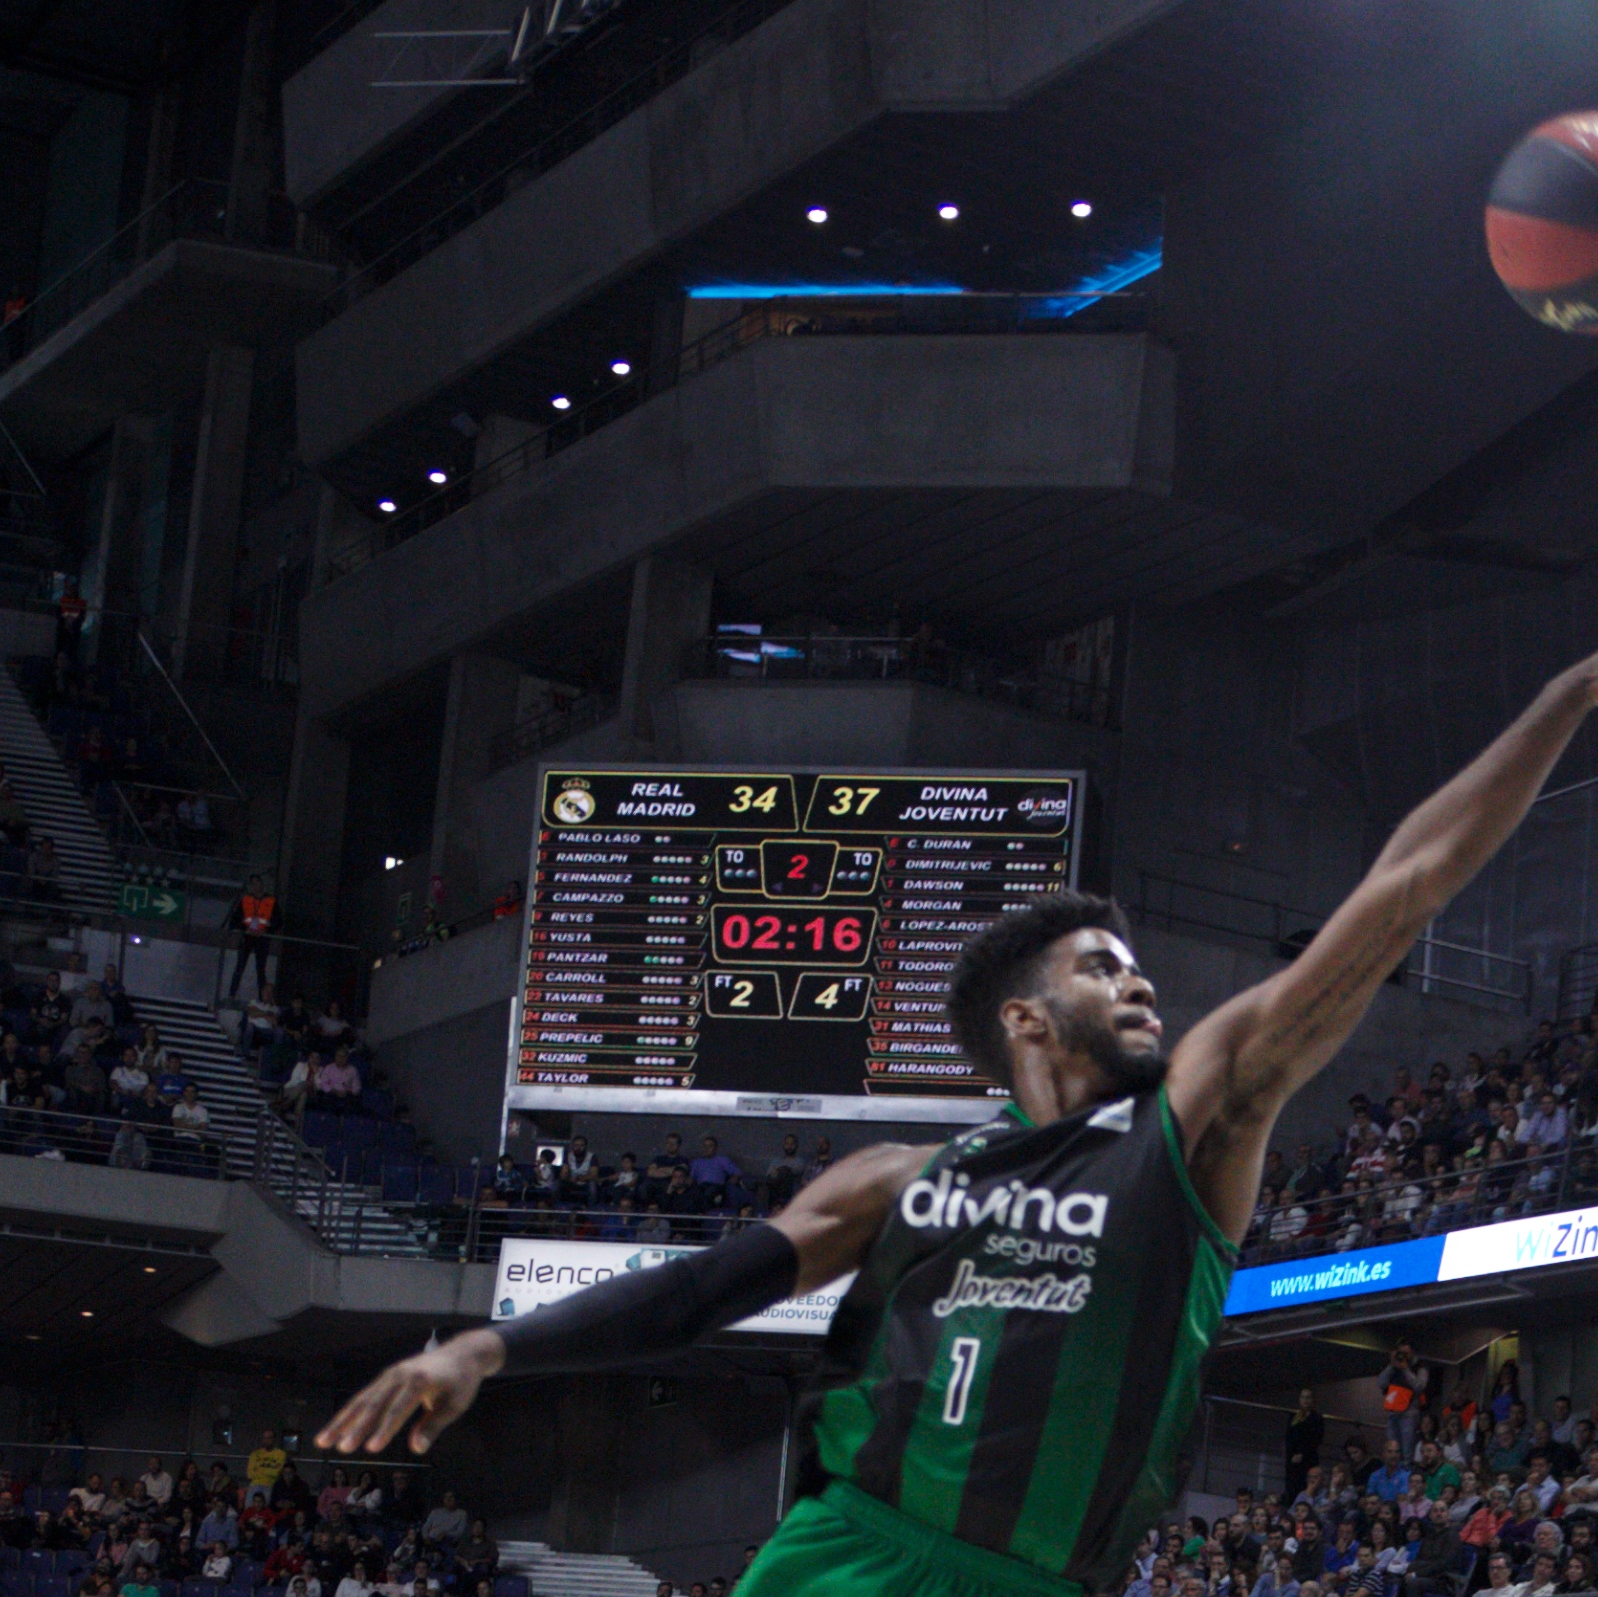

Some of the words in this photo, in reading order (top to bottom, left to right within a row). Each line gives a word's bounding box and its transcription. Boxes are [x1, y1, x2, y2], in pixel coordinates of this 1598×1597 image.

[631, 782, 685, 797] REAL
[920, 786, 988, 801] DIVINA
[729, 785, 778, 813] 34
[828, 787, 880, 815] 37
[1017, 798, 1067, 812] divina
[616, 802, 696, 817] MADRID
[899, 806, 1009, 821] JOVENTUT
[558, 833, 602, 843] PABLO
[605, 833, 641, 844] LASO
[924, 839, 972, 850] DURAN
[556, 852, 628, 863] RANDOLPH
[726, 850, 744, 863] TO
[854, 853, 872, 866] TO
[787, 854, 809, 879] 2
[905, 859, 992, 871] DIMITRIJEVIC
[1053, 860, 1062, 871] 6
[554, 872, 632, 884] FERNANDEZ
[903, 880, 964, 891] DAWSON
[1047, 881, 1060, 892] 11
[553, 892, 624, 903] CAMPAZZO
[901, 900, 963, 911] MORGAN
[550, 912, 594, 923] REYES
[695, 914, 703, 925] 2
[549, 932, 592, 943] YUSTA
[722, 914, 862, 951] 02:16
[546, 952, 608, 963] PANTZAR
[880, 960, 893, 969] 11
[545, 972, 607, 984] CARROLL
[689, 975, 698, 985] 3
[714, 975, 733, 988] FT
[729, 981, 754, 1008] 2
[895, 981, 952, 992] NOGUES
[544, 992, 604, 1003] TAVARES
[688, 995, 696, 1005] 2
[814, 983, 840, 1009] 4
[844, 978, 863, 991] FT
[541, 1012, 579, 1023] DECK
[686, 1016, 694, 1026] 3
[891, 1022, 952, 1033] MATHIAS
[539, 1032, 604, 1043] PREPELIC
[889, 1043, 961, 1054] BIRGANDE
[537, 1052, 588, 1063] KUZMIC
[888, 1063, 974, 1075] HARANGODY
[537, 1072, 589, 1084] TAYLOR
[901, 1168, 1108, 1238] divina
[984, 1232, 1097, 1268] seguros
[506, 1258, 614, 1285] elenco
[505, 1287, 573, 1296] AUDIOV
[932, 1259, 1092, 1318] Joventut
[942, 1337, 981, 1426] 1
